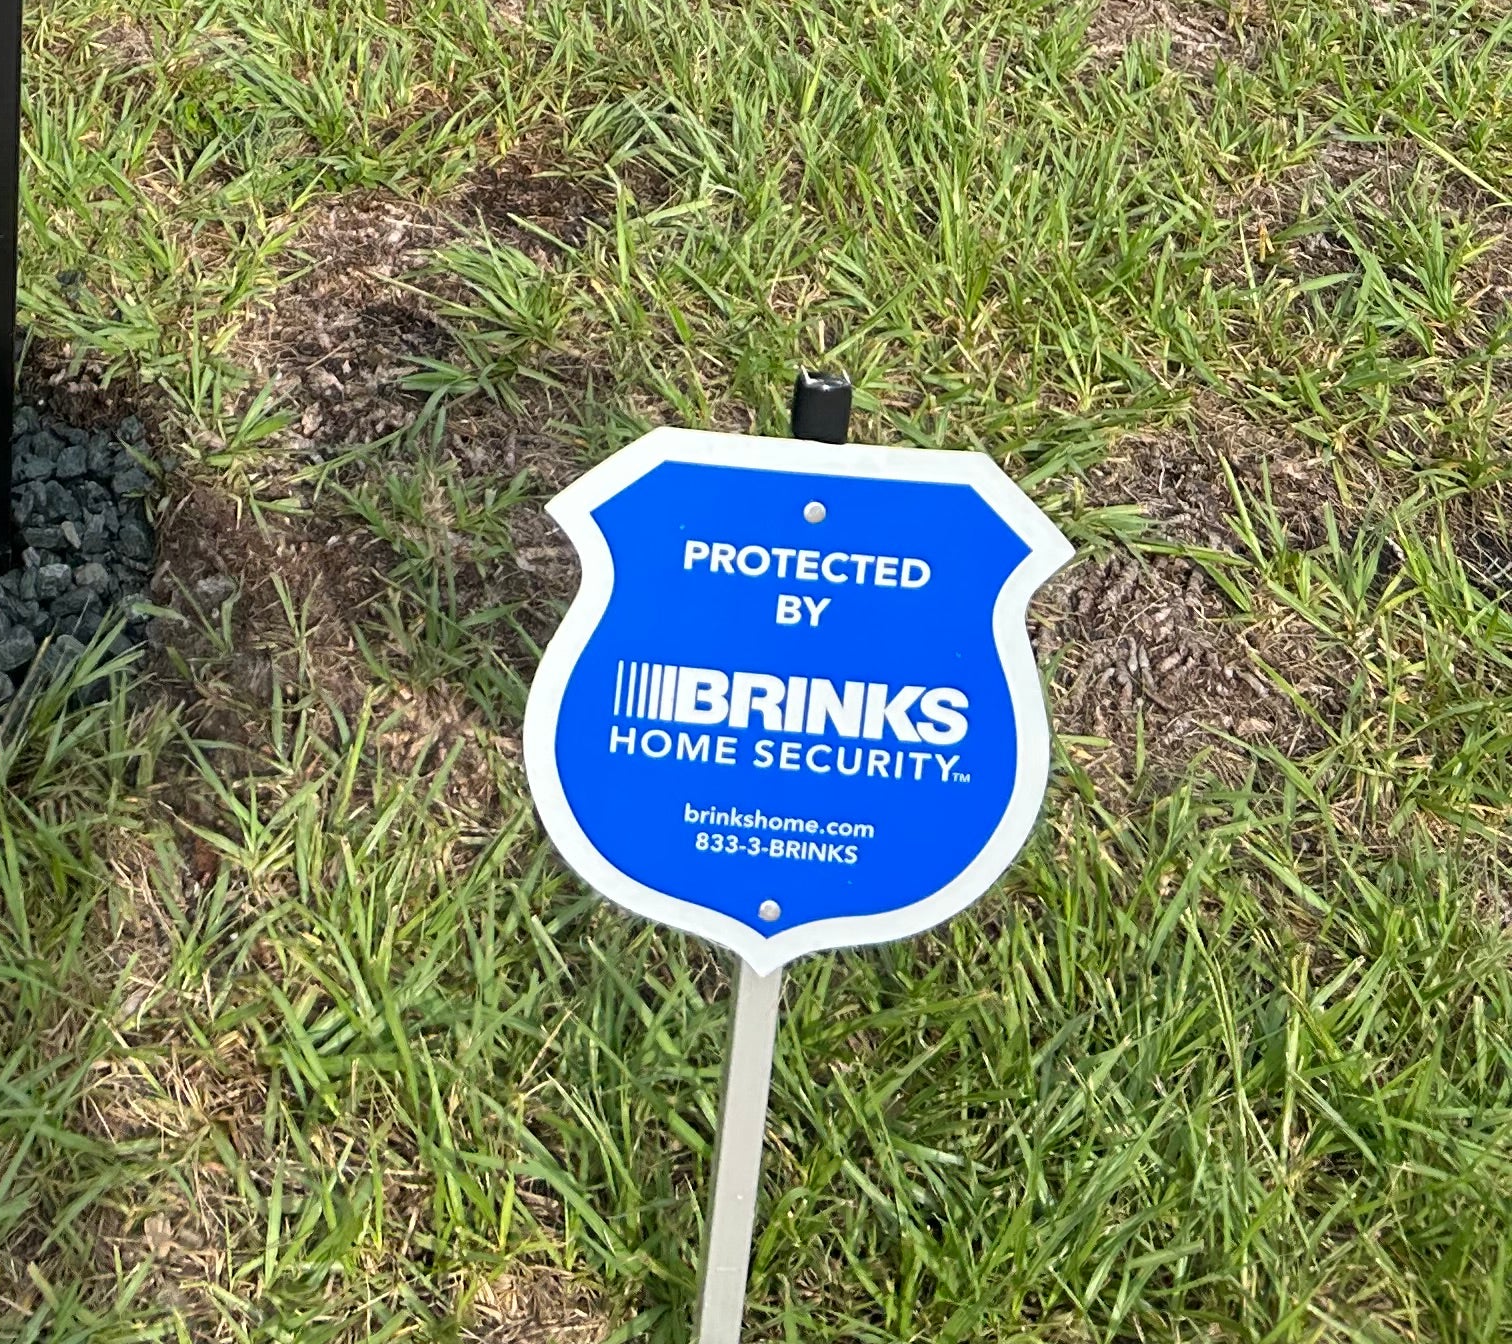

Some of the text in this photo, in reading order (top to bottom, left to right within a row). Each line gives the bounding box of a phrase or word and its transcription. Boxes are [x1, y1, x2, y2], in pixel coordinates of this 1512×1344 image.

[683, 540, 931, 589] PROTECTED
[775, 594, 832, 627] BY
[673, 666, 969, 746] BRINKS
[609, 725, 738, 765] HOME
[684, 802, 875, 838] brinkshome.com
[695, 831, 858, 864] 833-3-BRINKS
